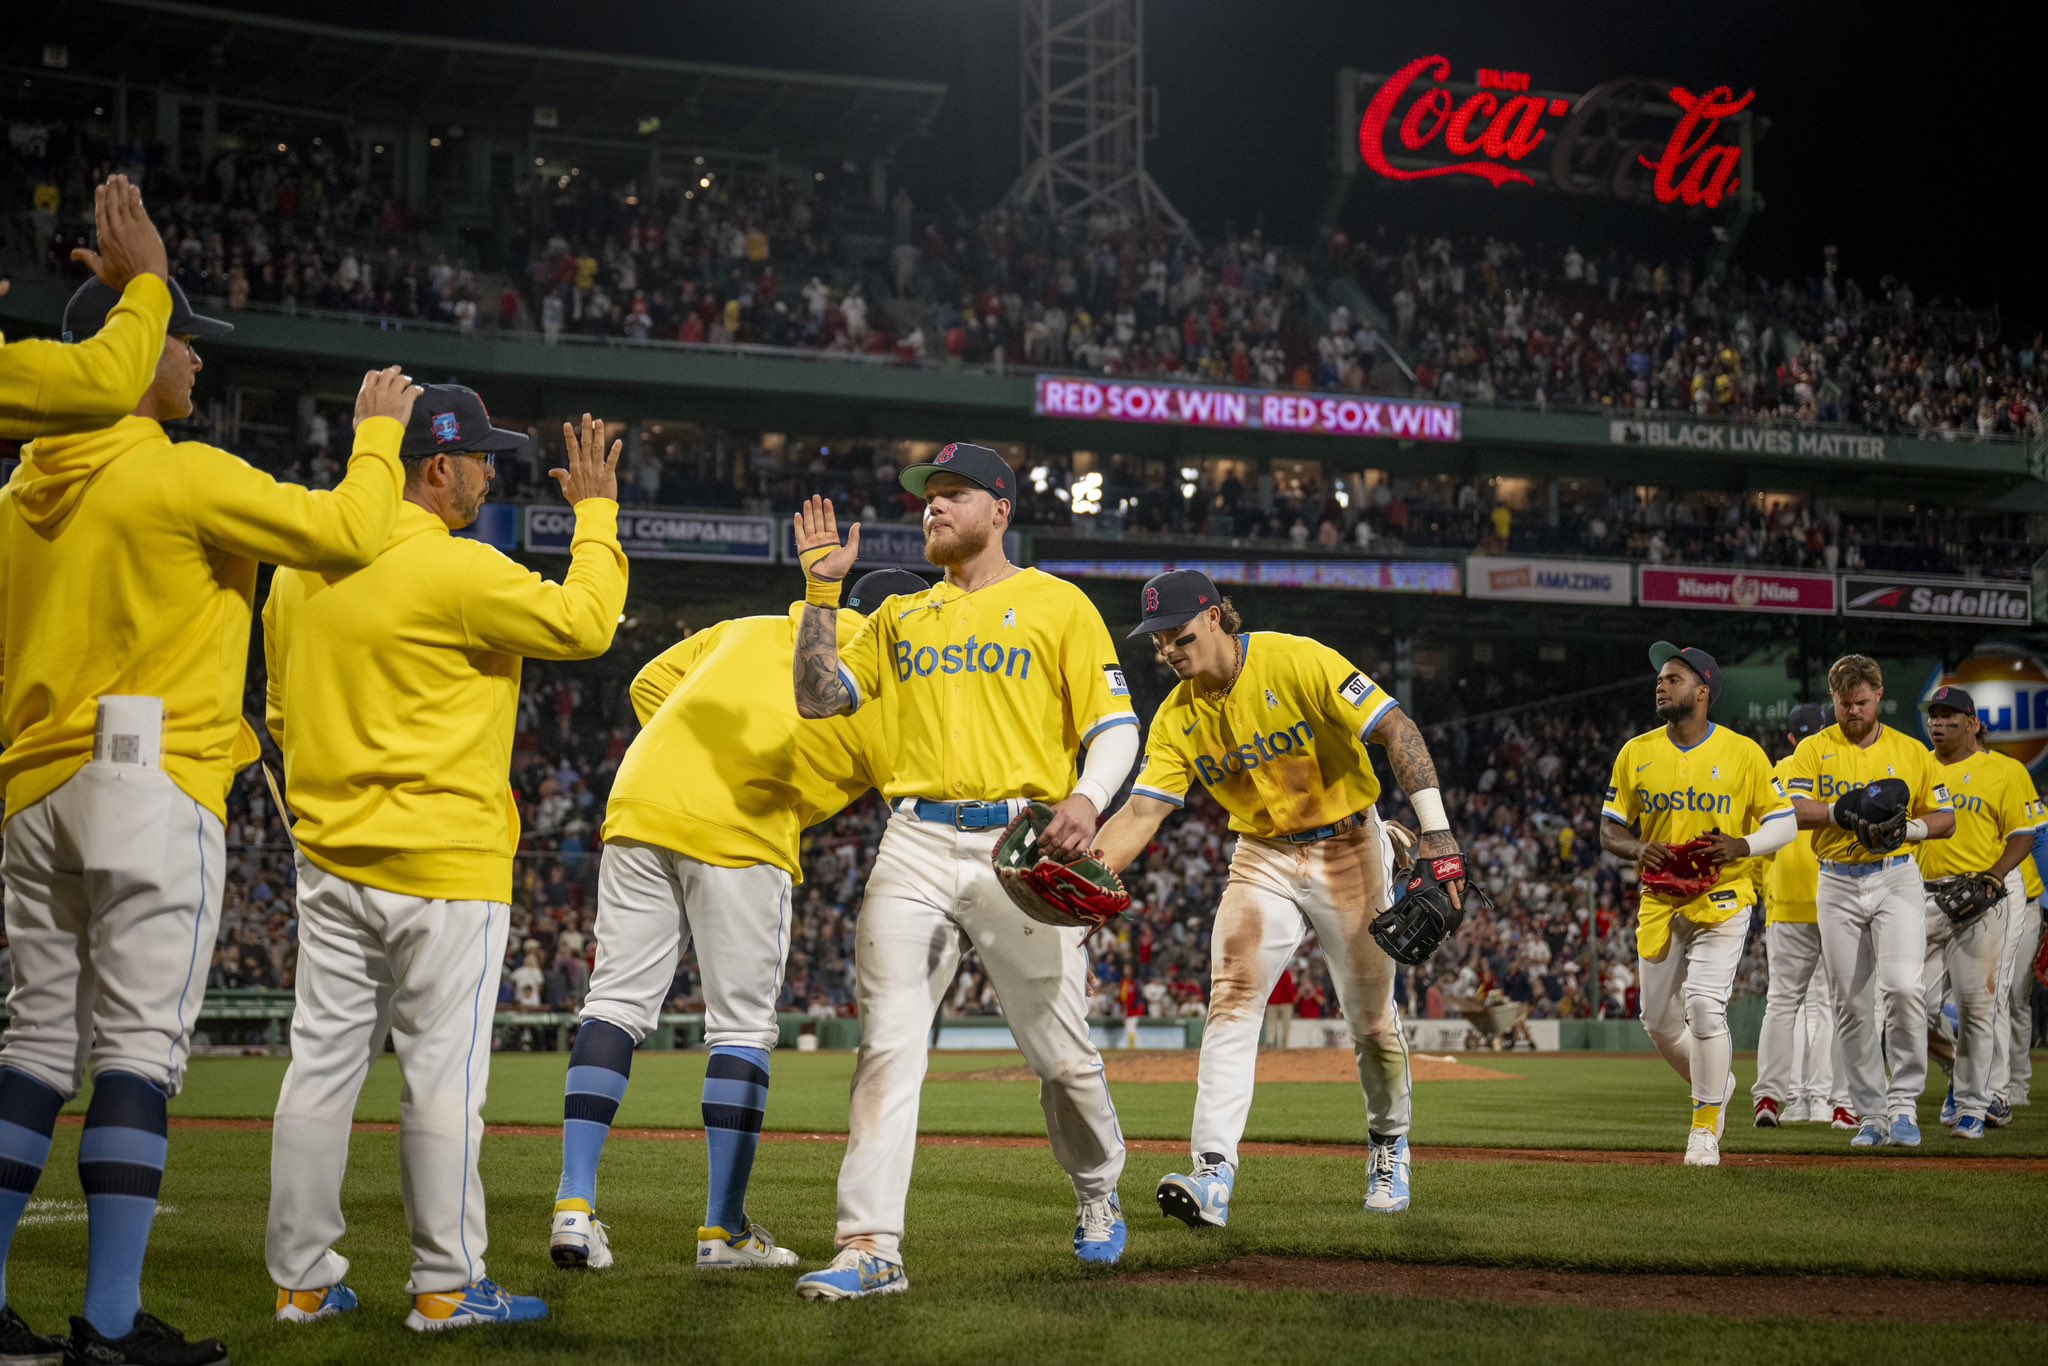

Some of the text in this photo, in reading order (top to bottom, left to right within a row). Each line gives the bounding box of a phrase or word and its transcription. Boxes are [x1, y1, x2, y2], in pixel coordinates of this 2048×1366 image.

[1046, 381, 1455, 437] RED SOX WIN RED SOX WIN
[1648, 422, 1885, 460] BLACK LIVES MATTER
[635, 517, 769, 543] COMPANIES
[1535, 571, 1612, 592] AMAZING
[1678, 577, 1730, 601] Ninety
[1761, 581, 1799, 603] Nine
[1145, 587, 1159, 612] B
[1909, 586, 2026, 618] Safelite
[893, 634, 1031, 683] Boston
[1348, 678, 1367, 696] 617
[1977, 690, 2048, 732] ulf
[1194, 720, 1314, 787] Boston
[1638, 786, 1731, 815] Boston
